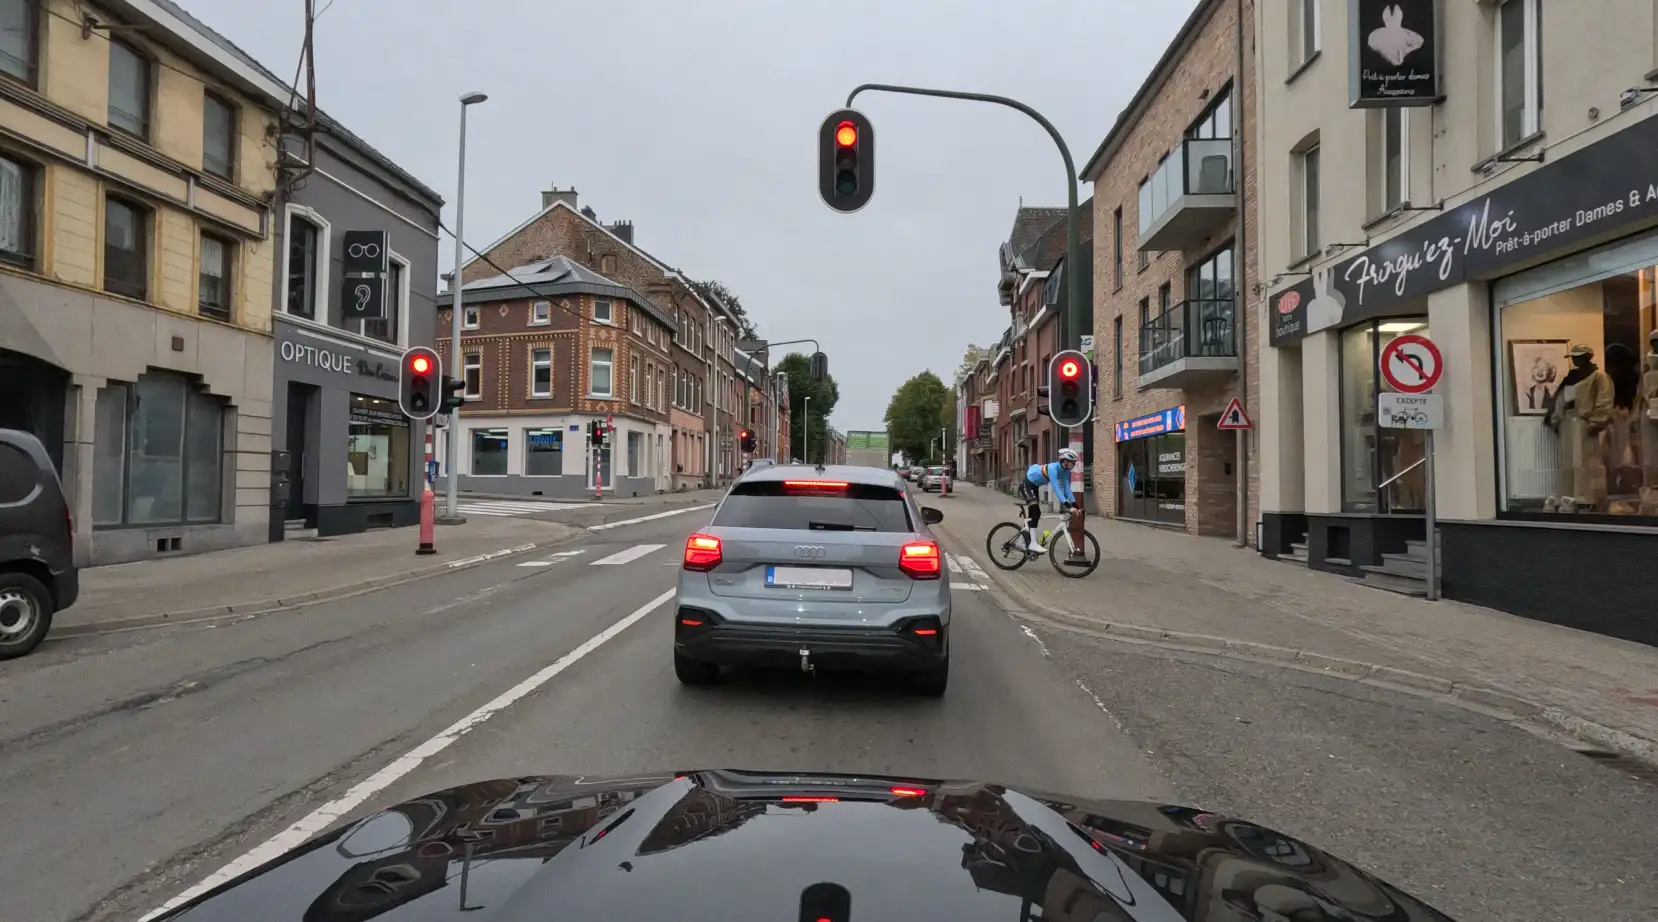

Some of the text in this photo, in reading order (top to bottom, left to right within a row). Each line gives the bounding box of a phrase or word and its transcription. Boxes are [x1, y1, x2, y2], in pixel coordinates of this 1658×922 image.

[1385, 71, 1406, 88] porter
[1495, 183, 1658, 256] Prêt-à-porter Dames & A
[1275, 320, 1300, 338] boutique
[281, 340, 352, 374] OPTIQUE
